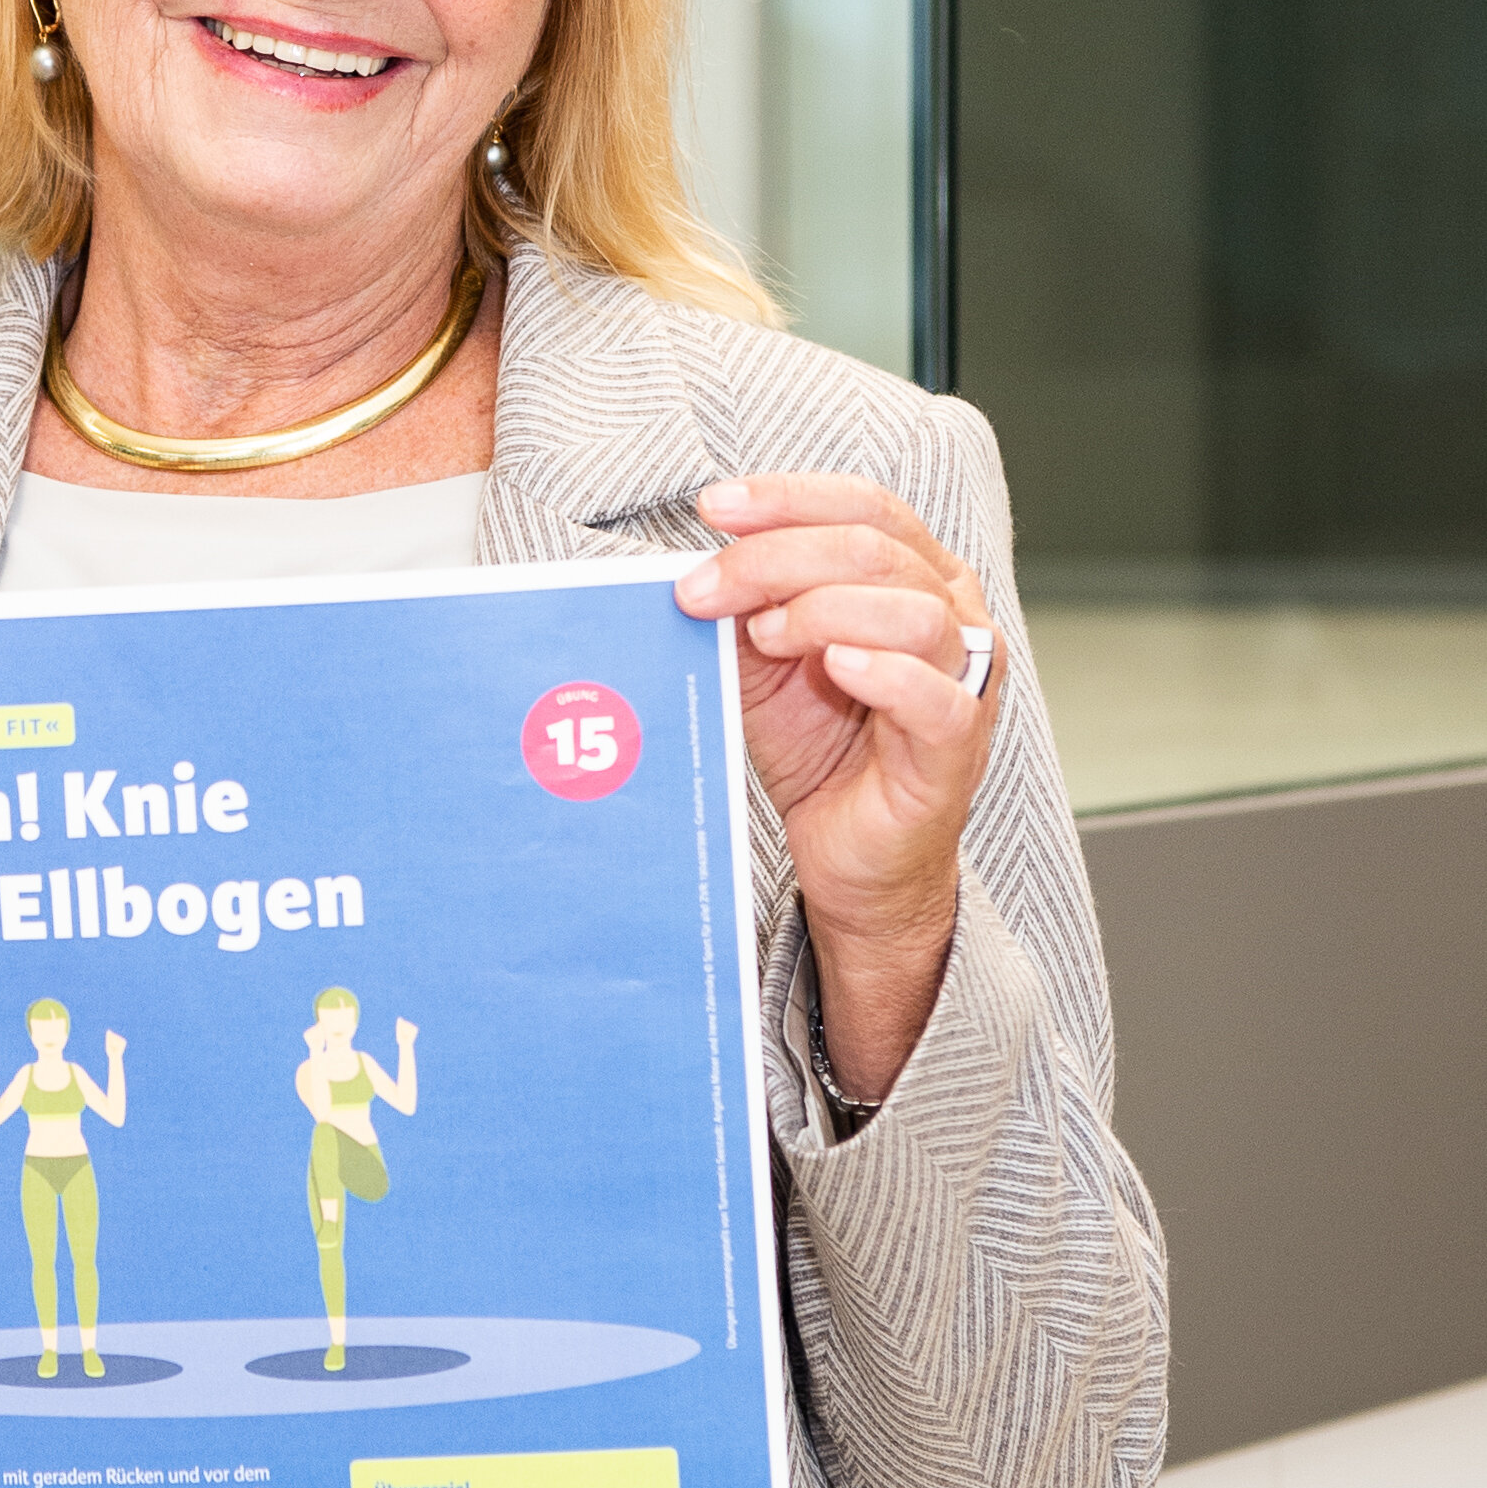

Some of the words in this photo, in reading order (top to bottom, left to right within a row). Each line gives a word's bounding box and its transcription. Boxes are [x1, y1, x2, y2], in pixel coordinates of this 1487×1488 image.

[545, 715, 618, 771] 15
[63, 760, 249, 839] Knie
[2, 1469, 30, 1486] mit
[105, 1466, 164, 1485] Rücken
[167, 1465, 200, 1484] und
[203, 1468, 230, 1483] vor
[233, 1464, 270, 1482] dem
